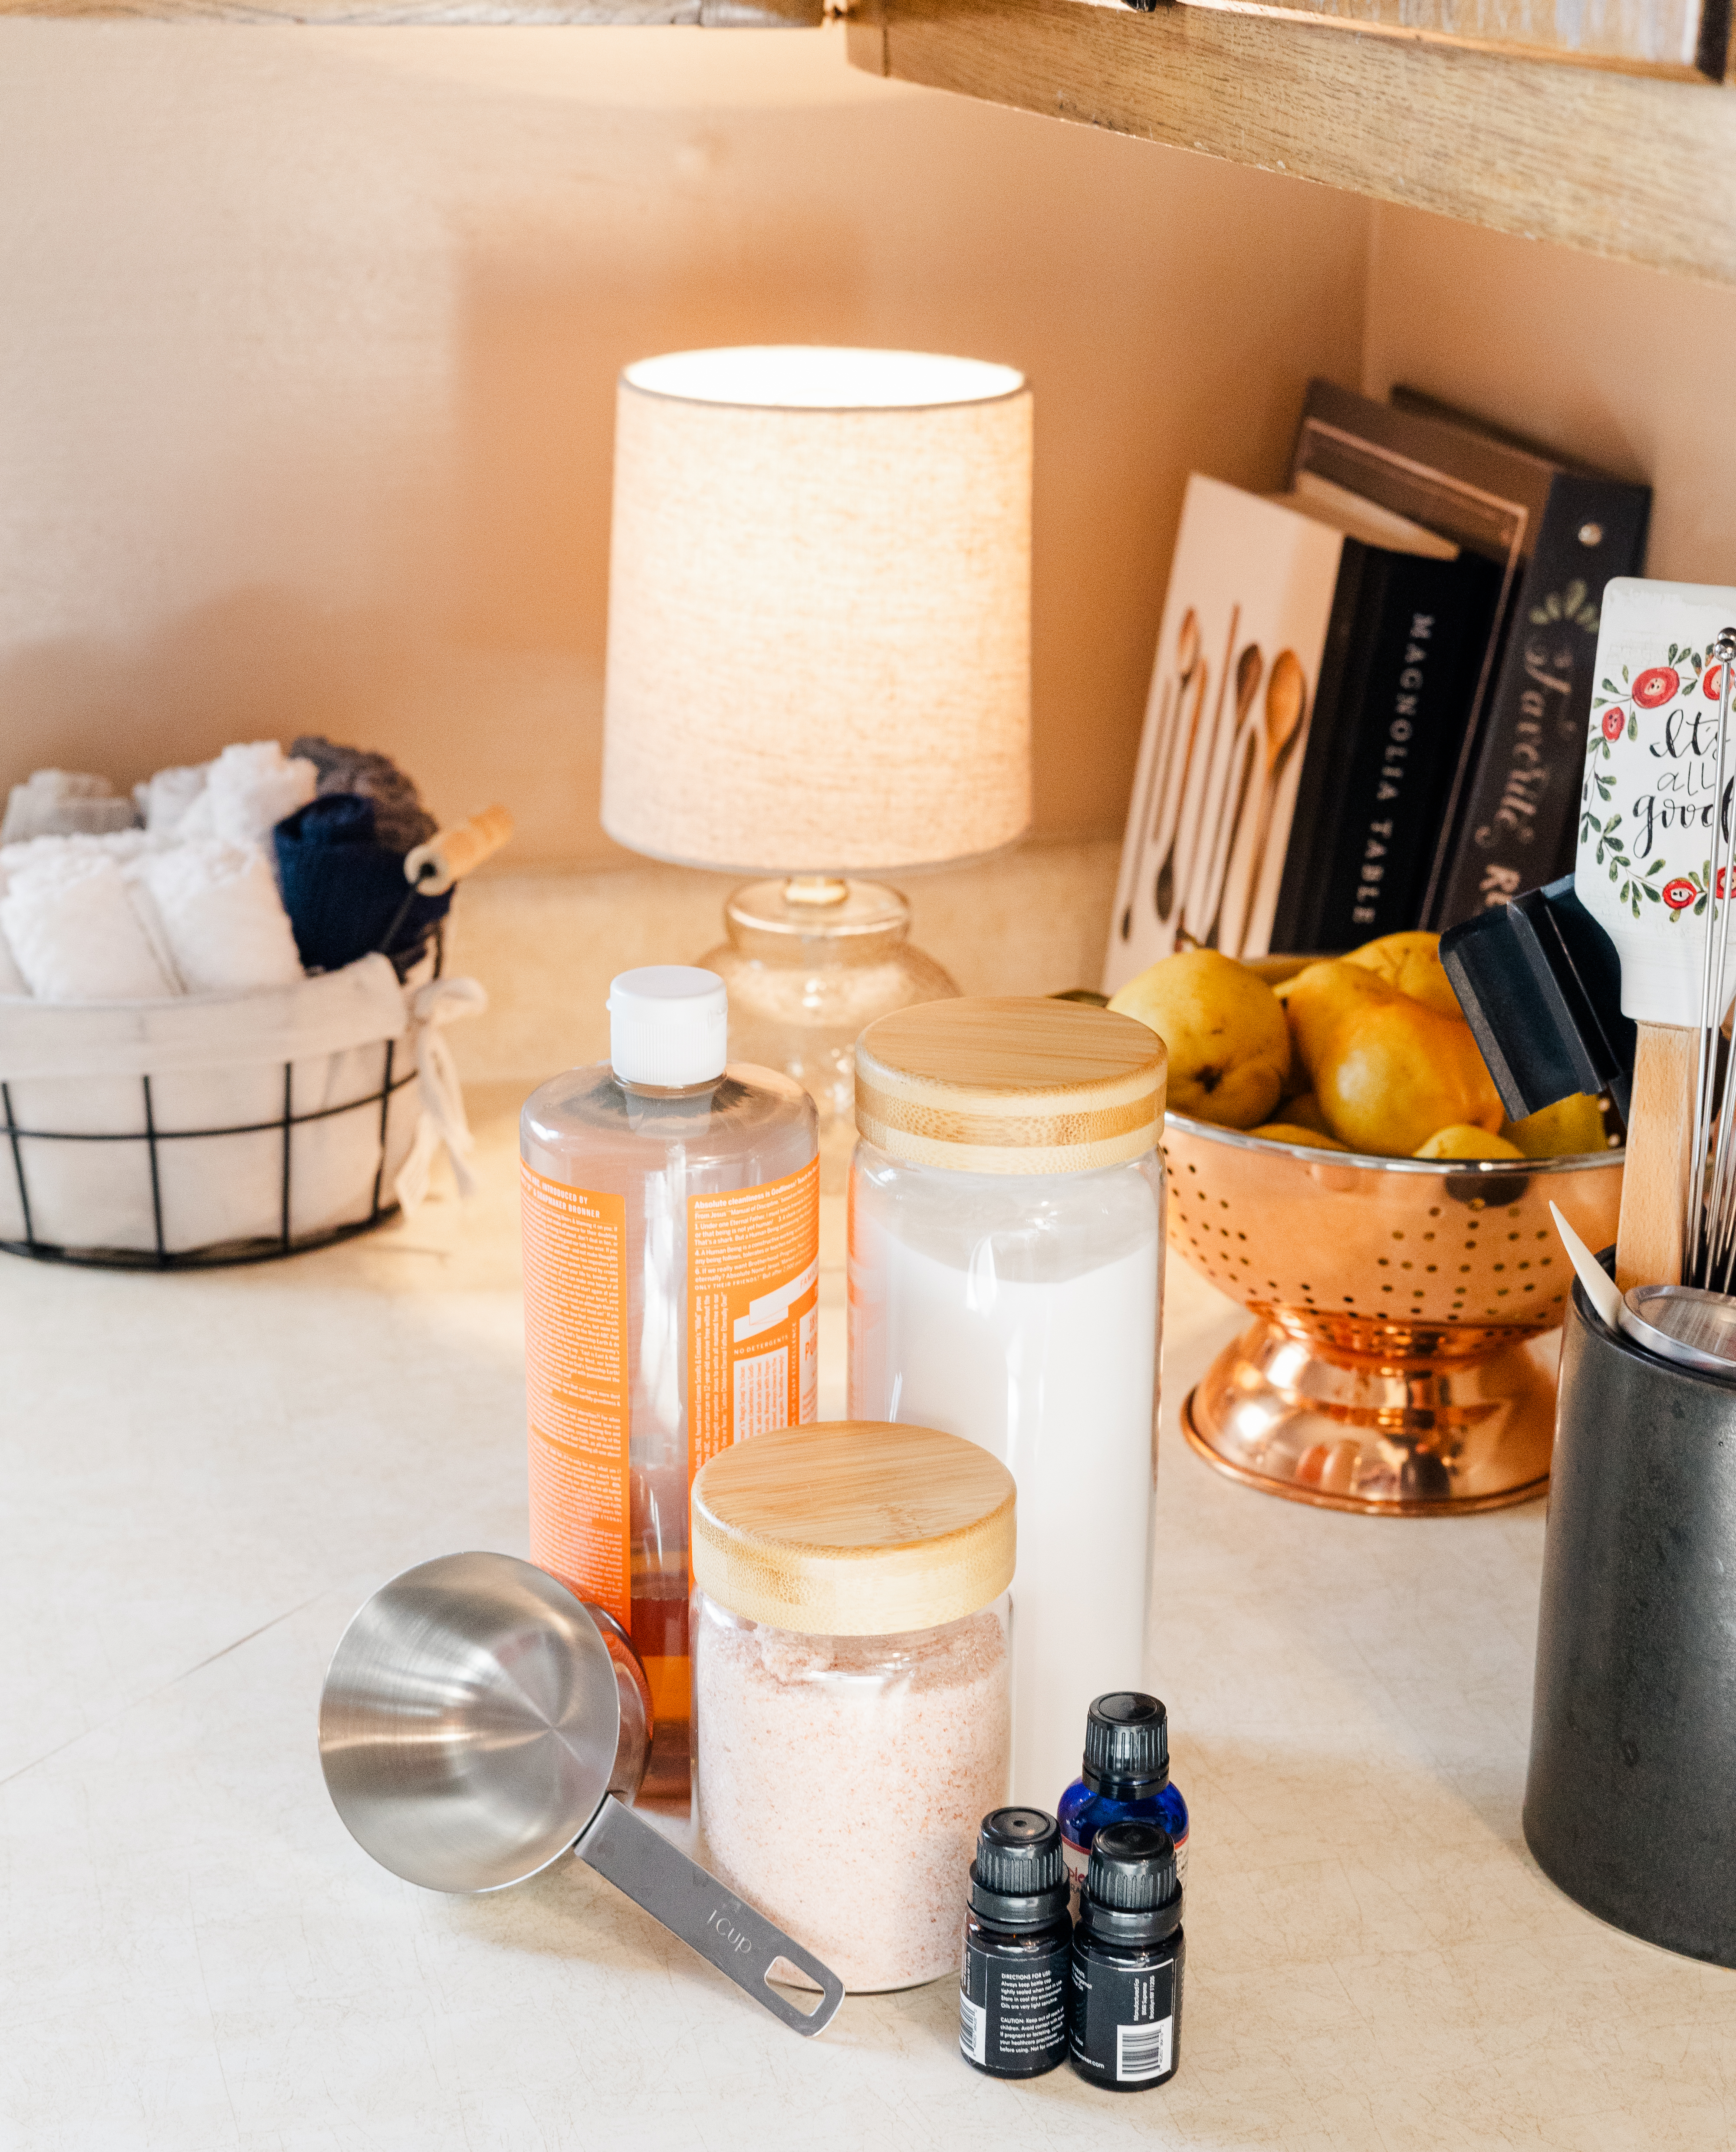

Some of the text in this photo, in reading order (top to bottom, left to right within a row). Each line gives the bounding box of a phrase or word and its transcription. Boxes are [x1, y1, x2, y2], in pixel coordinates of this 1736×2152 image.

[1352, 612, 1436, 925] MAGNOLIA TABLE
[1657, 761, 1716, 796] all
[542, 1181, 588, 1205] INTRODUCED BY
[694, 1199, 727, 1209] Absolute
[728, 1193, 764, 1206] cleanliness
[771, 1179, 797, 1196] Godliness!
[533, 1188, 600, 1219] & SOAPMAKER BRONNER
[576, 1219, 592, 1229] blaming
[730, 1217, 749, 1226] Eternal
[756, 1219, 773, 1229] human!
[749, 1230, 766, 1239] Human
[752, 1237, 779, 1248] constructive
[743, 1249, 764, 1258] tolerates
[695, 1265, 766, 1283] eternally? Absolute None!
[746, 1334, 788, 1353] DETERGENTS
[716, 1918, 751, 1953] Cup
[1051, 2009, 1060, 2017] reach
[1046, 2037, 1059, 2048] internal
